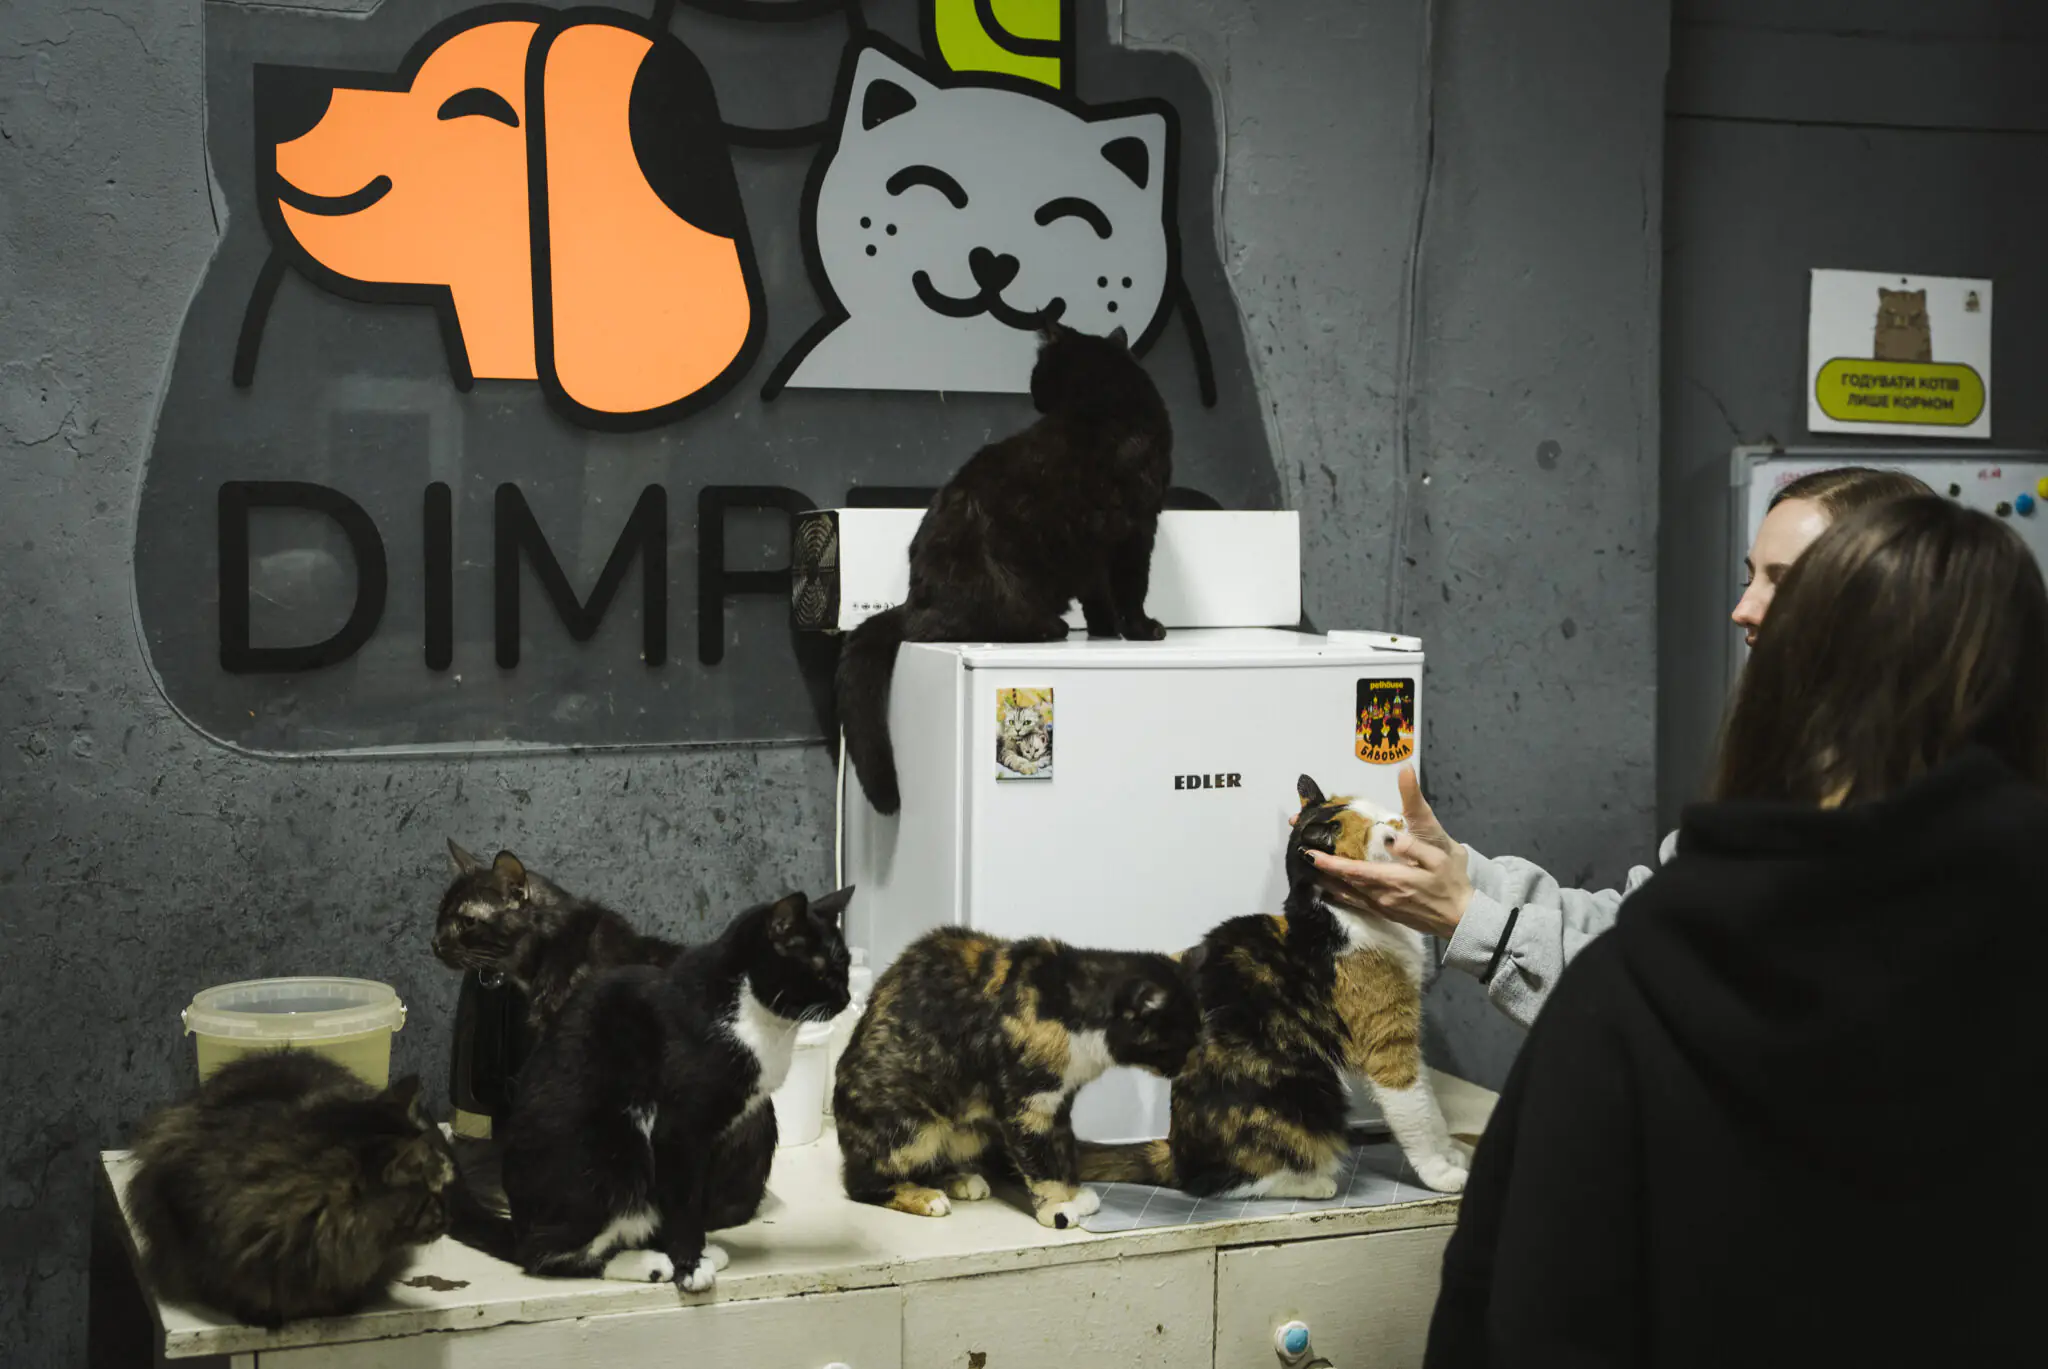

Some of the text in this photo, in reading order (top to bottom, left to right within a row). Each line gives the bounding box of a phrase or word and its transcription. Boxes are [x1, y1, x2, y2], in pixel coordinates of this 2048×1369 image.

[1841, 373, 1960, 391] ГОДУВАТИ КОТІВ
[1847, 393, 1954, 411] ЛИШЕ КОРМОМ
[1174, 773, 1242, 790] EDLER
